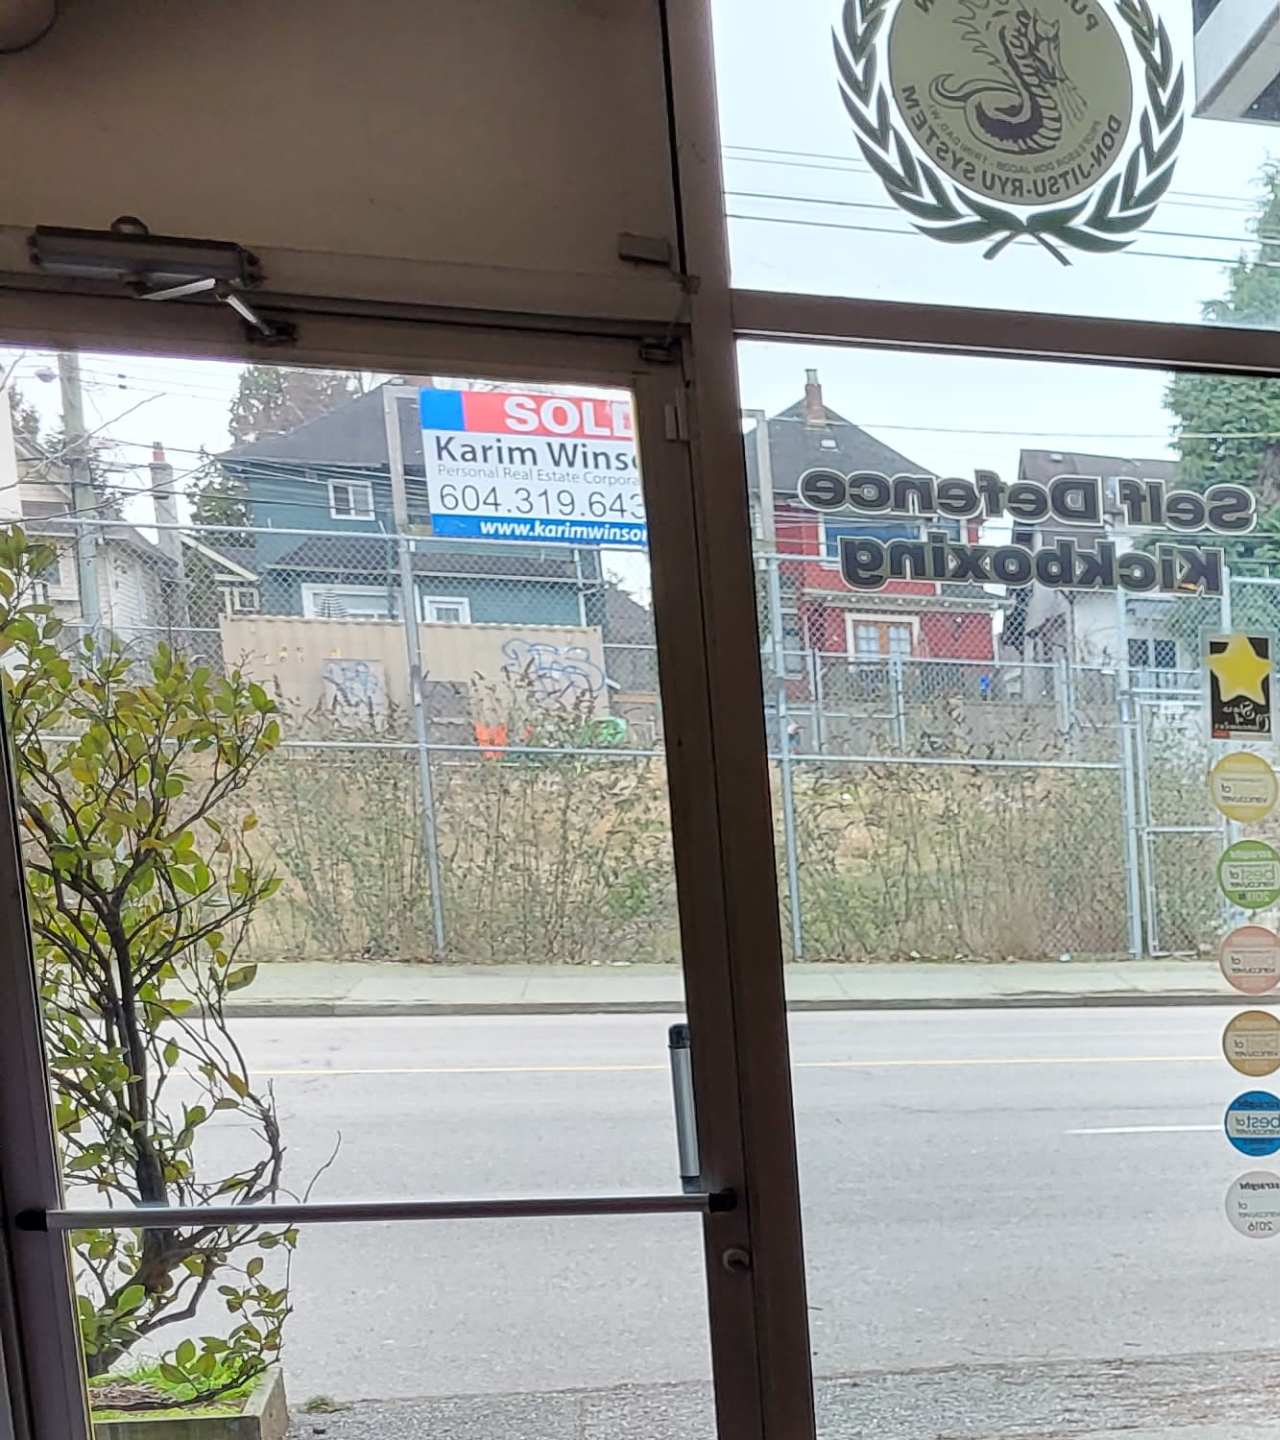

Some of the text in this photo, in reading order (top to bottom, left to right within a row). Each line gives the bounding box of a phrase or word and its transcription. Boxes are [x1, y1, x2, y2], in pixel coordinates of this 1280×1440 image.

[435, 435, 538, 466] Karim
[437, 463, 500, 480] Personal
[502, 467, 534, 481] Real
[536, 468, 580, 484] Estate
